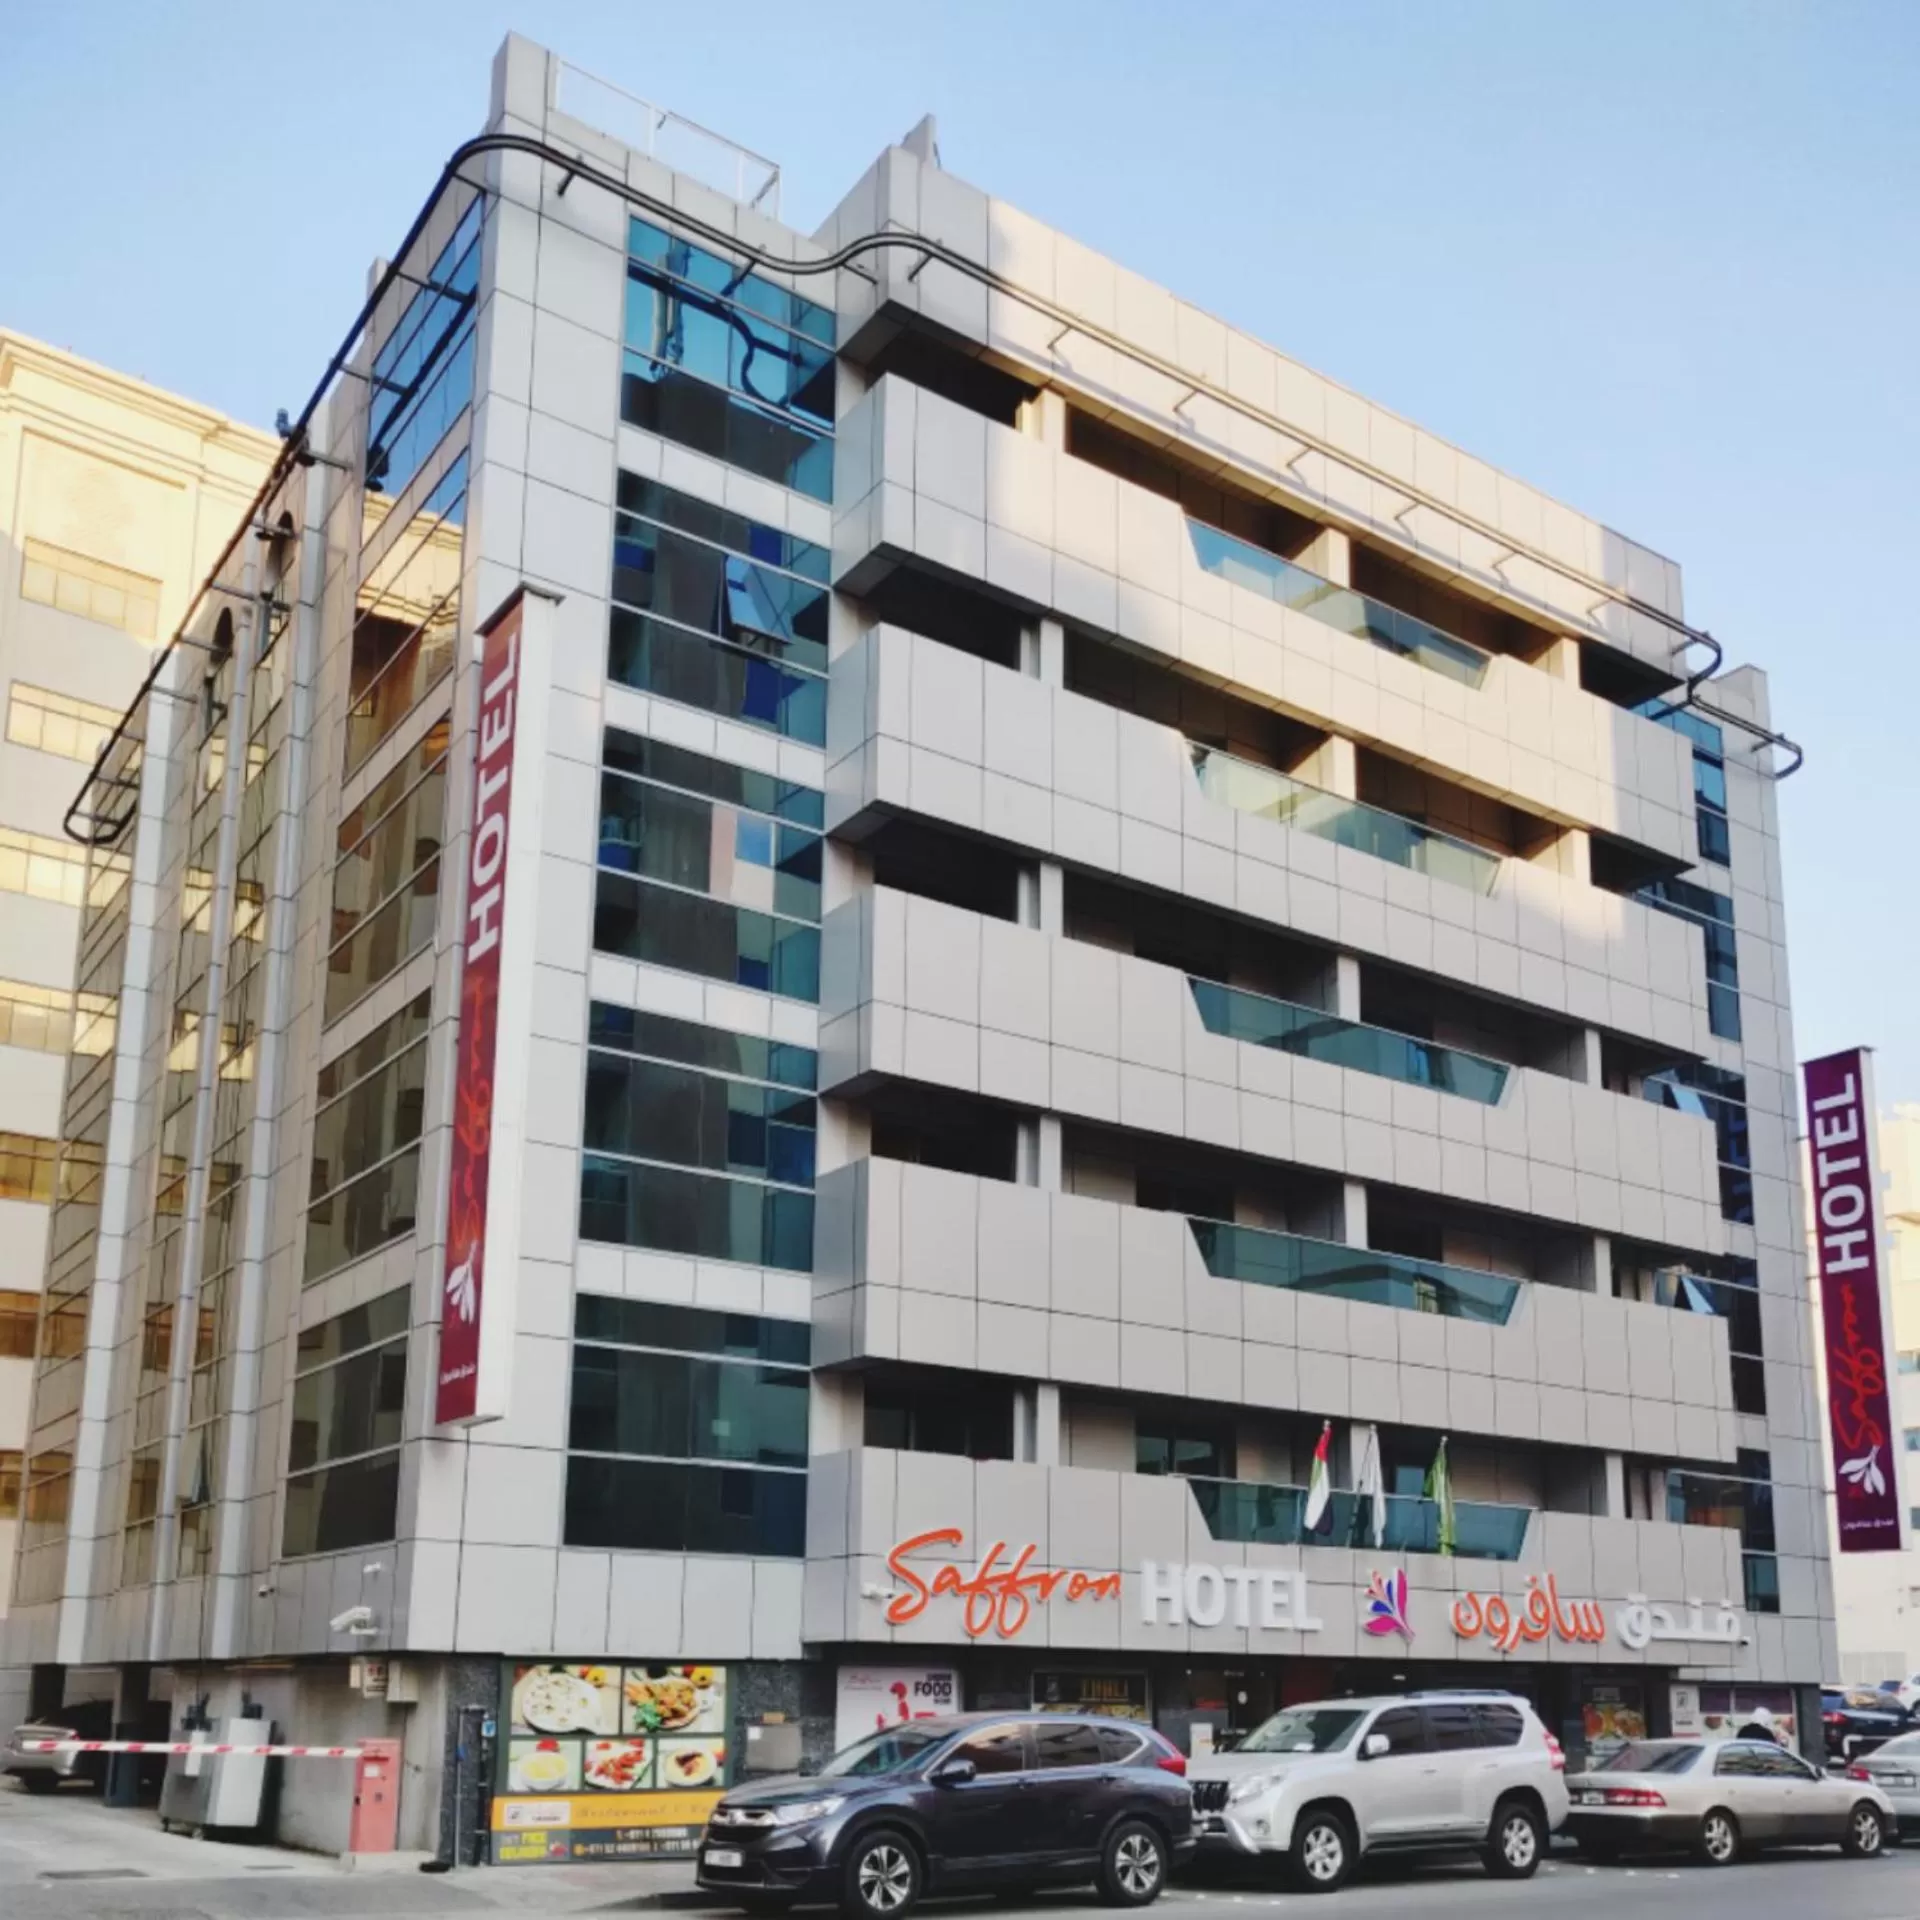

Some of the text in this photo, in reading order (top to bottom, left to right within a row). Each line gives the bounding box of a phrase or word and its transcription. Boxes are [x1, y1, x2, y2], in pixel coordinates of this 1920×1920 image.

[468, 631, 517, 964] HOTEL
[1813, 1073, 1870, 1274] HOTEL
[1832, 1281, 1885, 1450] Saffron
[884, 1527, 1324, 1638] Saffron HOTEL
[1449, 1568, 1741, 1652] فندق سافرون
[914, 1680, 952, 1697] FOOD
